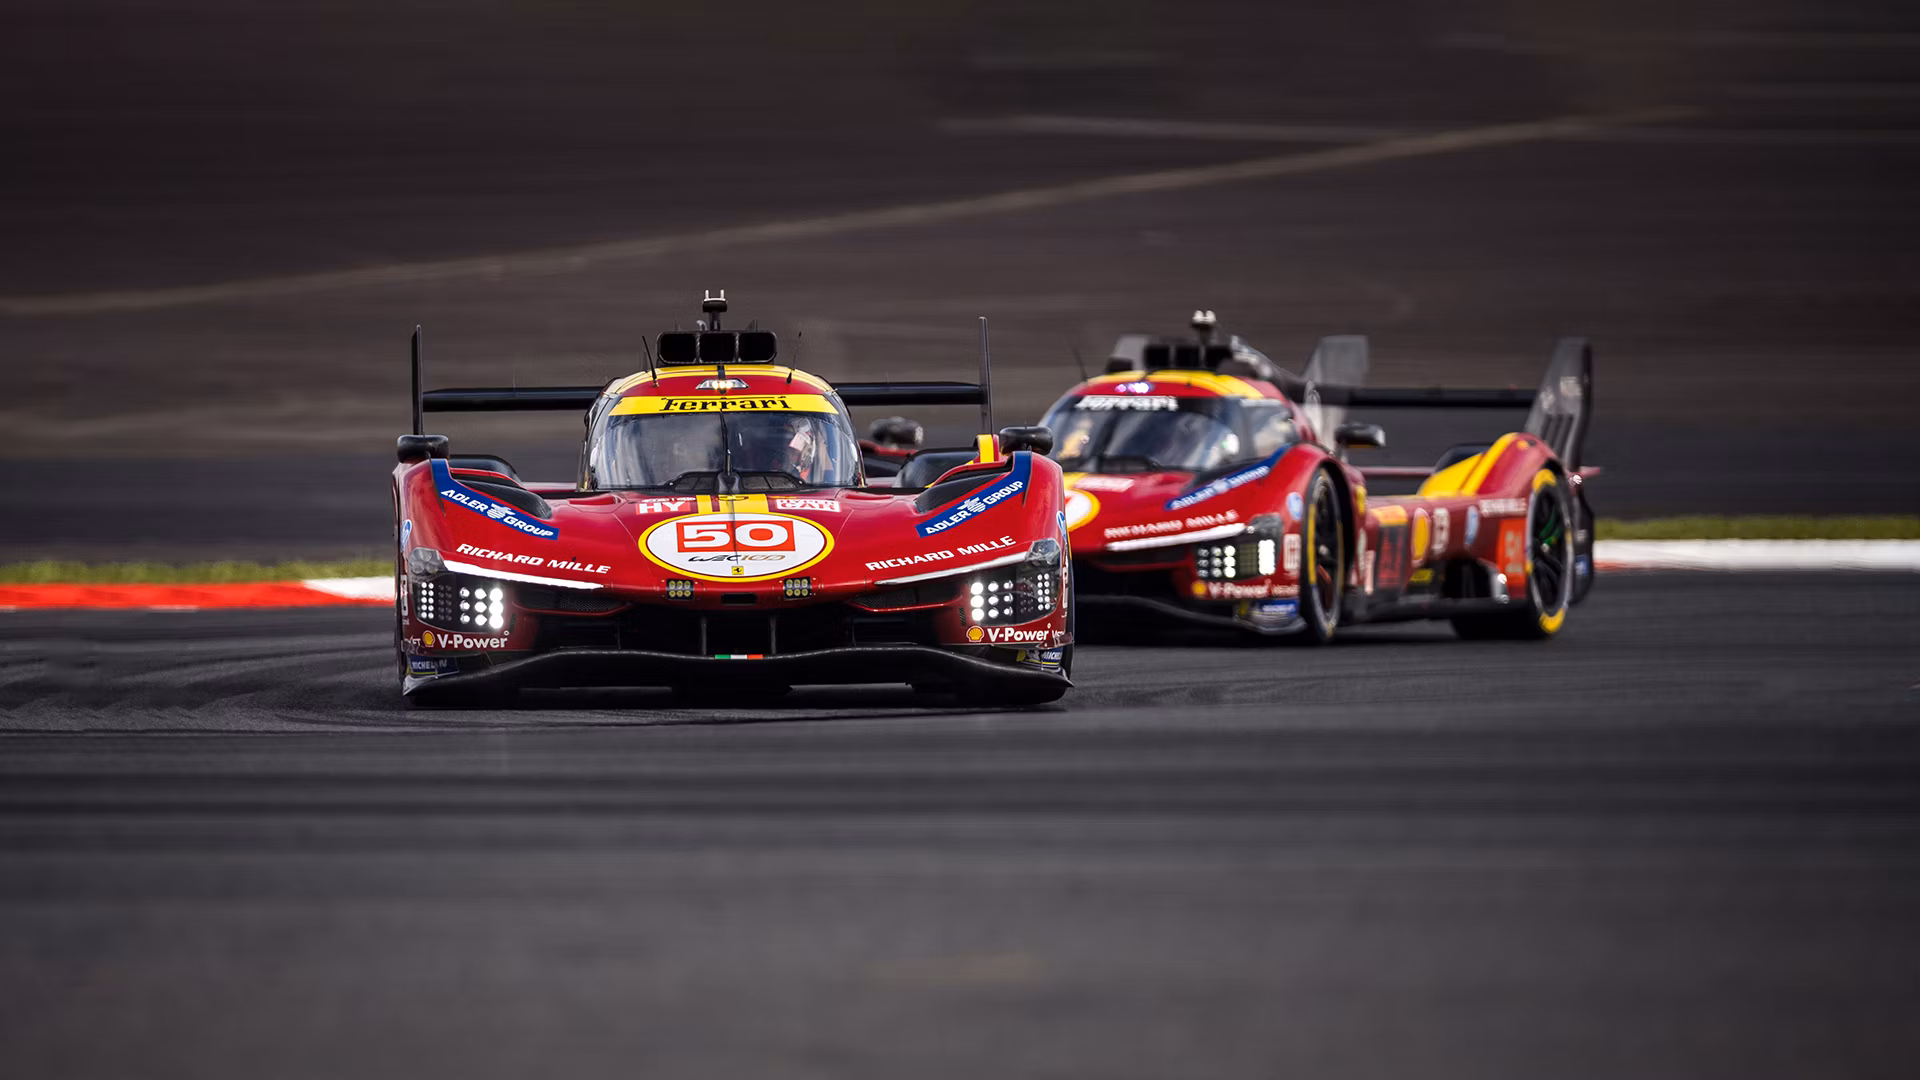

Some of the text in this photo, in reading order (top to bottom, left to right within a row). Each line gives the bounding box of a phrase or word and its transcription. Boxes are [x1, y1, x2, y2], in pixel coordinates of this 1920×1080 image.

[659, 396, 792, 411] Ferrari
[441, 489, 553, 537] ADLER GROUP
[640, 502, 685, 513] HY
[925, 481, 1023, 534] ADLER GROUP
[683, 523, 788, 548] 50
[1104, 519, 1183, 538] RICHARD
[456, 544, 611, 574] RICHARD MILLE
[865, 536, 1016, 570] RICHARD MILLE
[437, 634, 508, 648] V-Power
[987, 627, 1049, 642] V-Power
